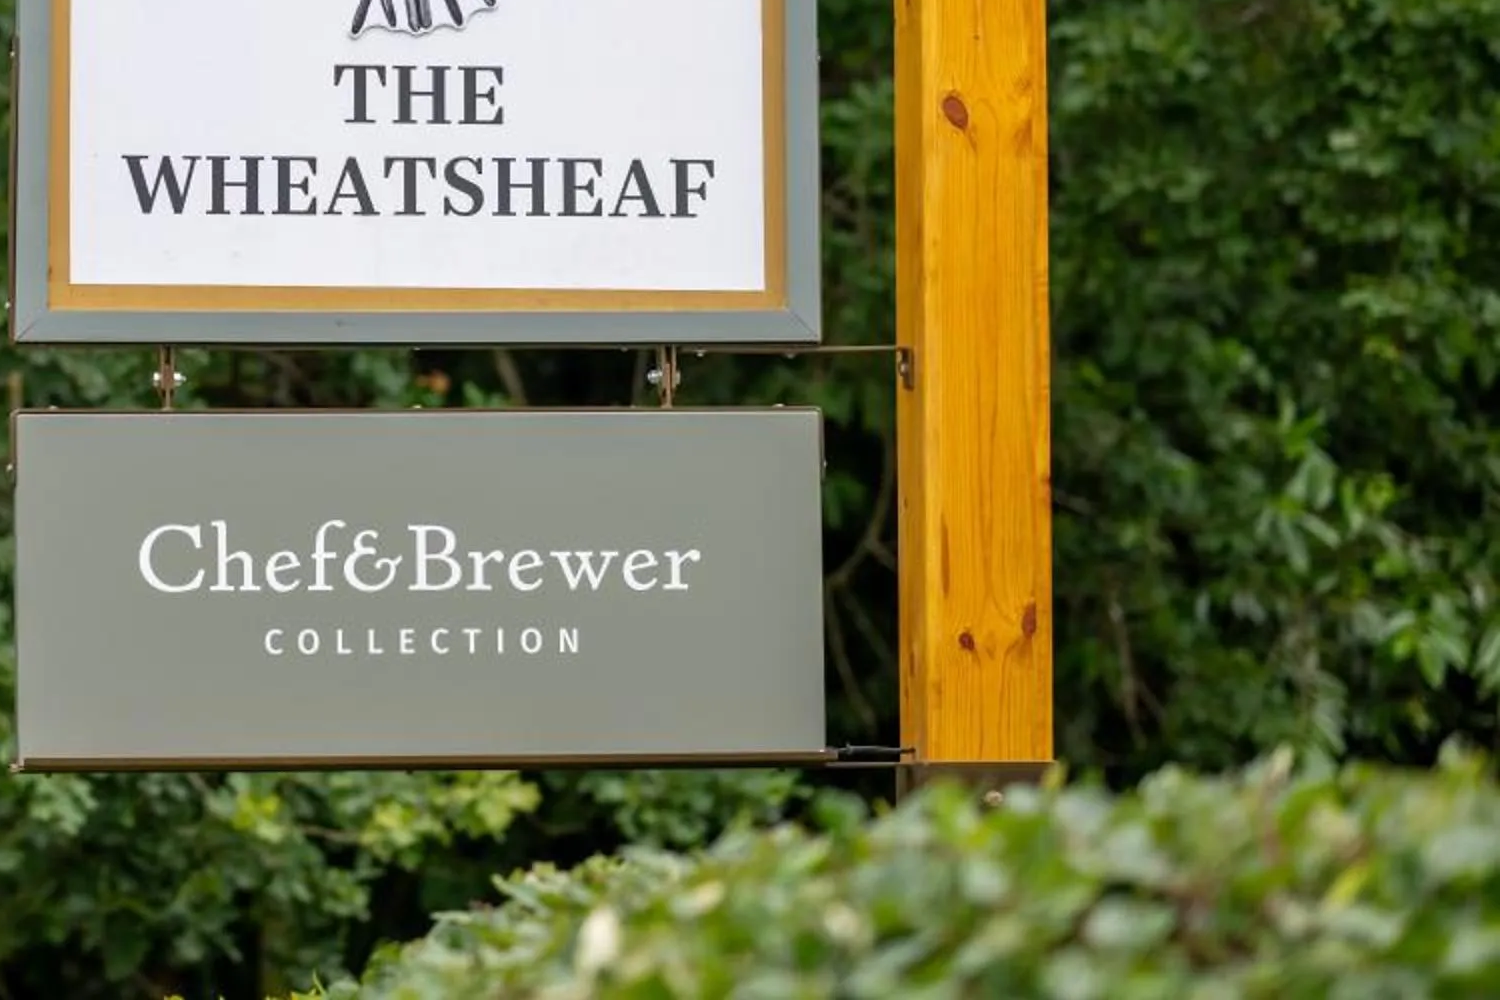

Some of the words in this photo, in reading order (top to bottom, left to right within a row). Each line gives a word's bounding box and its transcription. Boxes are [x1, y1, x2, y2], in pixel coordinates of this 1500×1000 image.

[333, 64, 505, 125] THE
[122, 154, 716, 218] WHEATSHEAF
[137, 518, 702, 594] Chef&Brewer
[264, 626, 582, 656] COLLECTION
